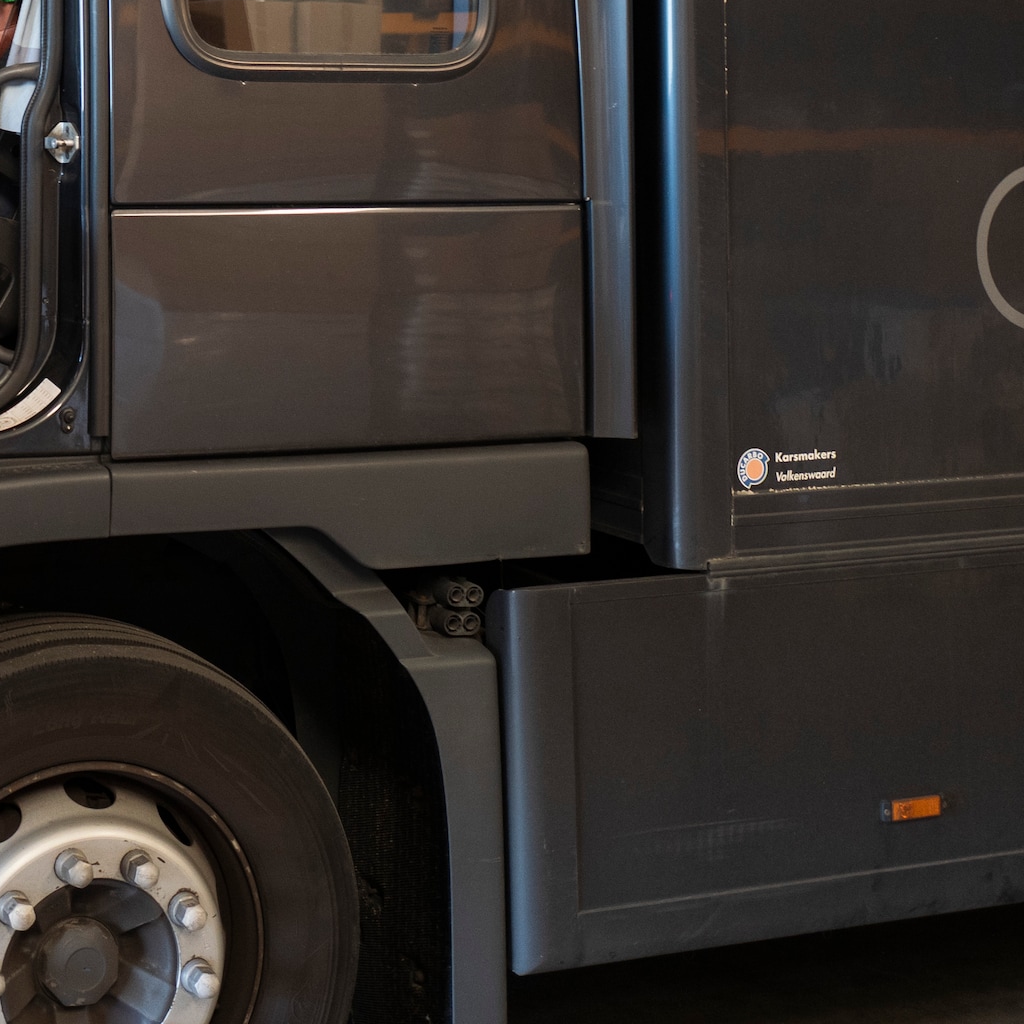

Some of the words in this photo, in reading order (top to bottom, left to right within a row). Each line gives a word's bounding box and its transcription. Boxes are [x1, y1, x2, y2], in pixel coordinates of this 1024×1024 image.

[775, 448, 837, 463] Karsmakers
[740, 451, 764, 482] DUCARBO
[775, 466, 836, 482] Valkenswaard
